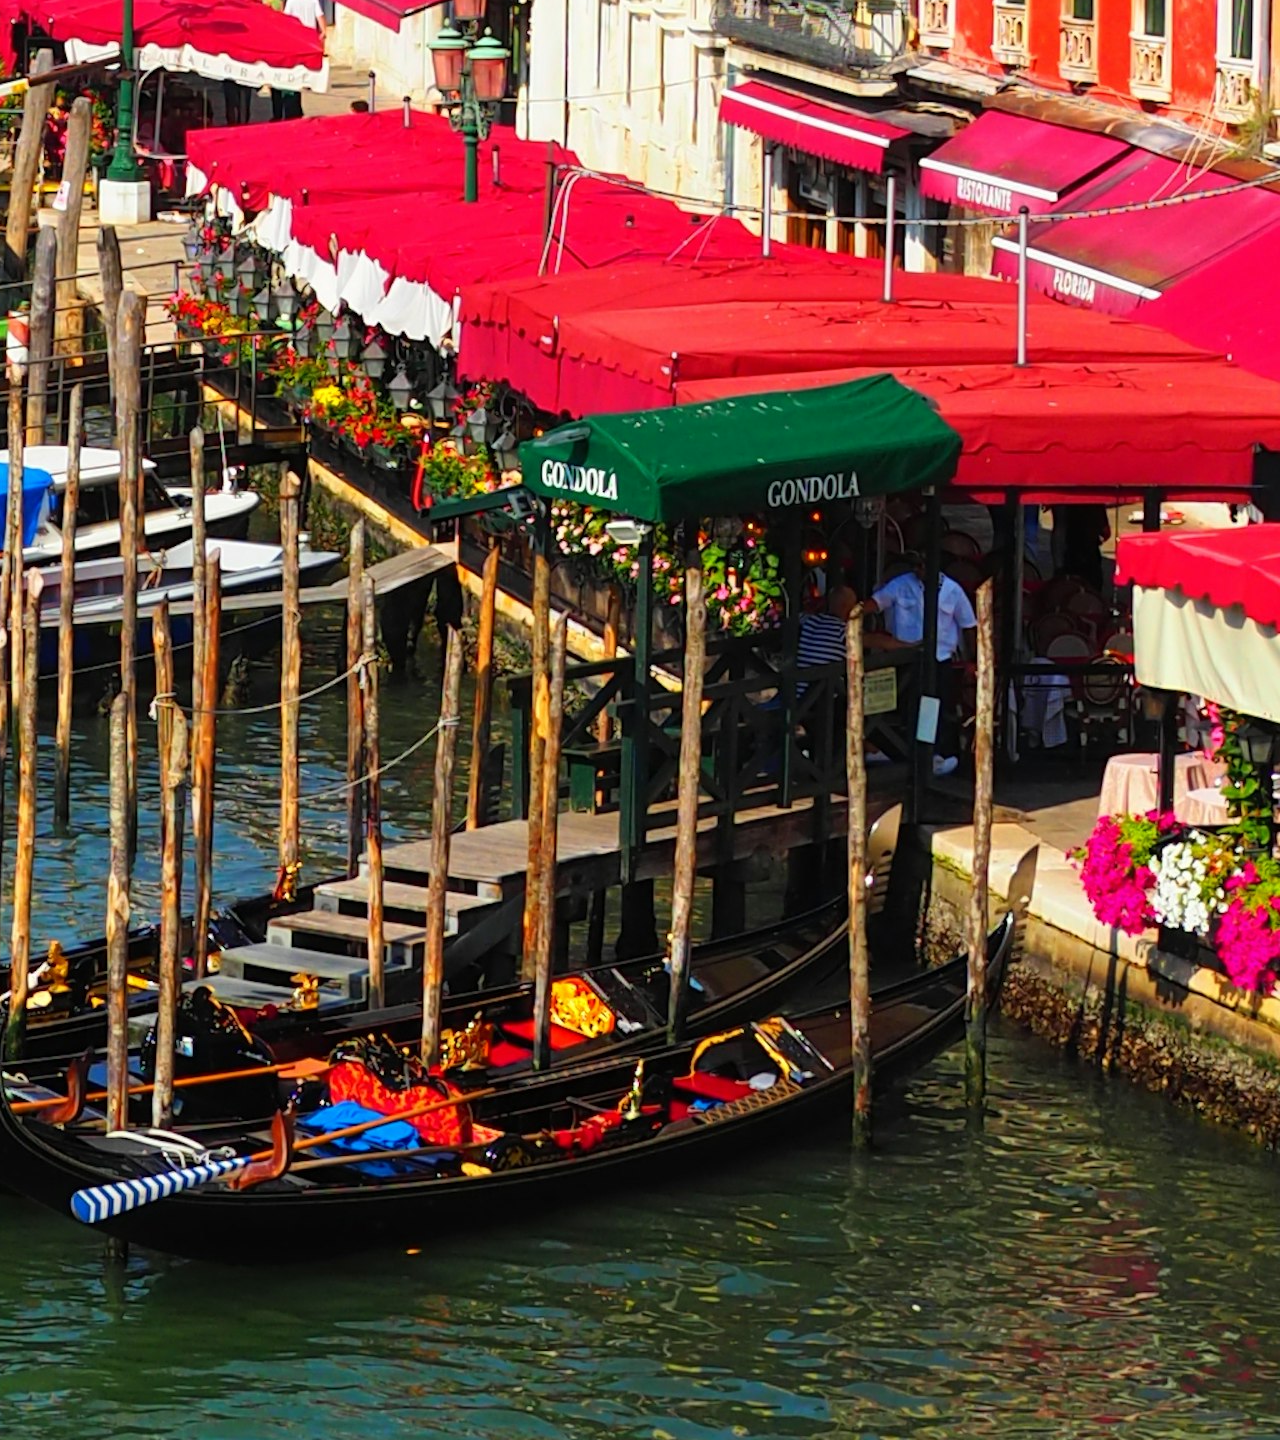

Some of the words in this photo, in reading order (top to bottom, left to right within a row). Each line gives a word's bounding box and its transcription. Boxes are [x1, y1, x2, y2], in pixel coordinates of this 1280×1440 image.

[141, 51, 210, 69] CANAL
[224, 63, 311, 83] GRANDE
[957, 176, 1012, 212] RISTORANTE
[1053, 268, 1096, 304] FLORIDA
[541, 458, 618, 501] GONDOLA
[767, 470, 860, 509] GONDOLA
